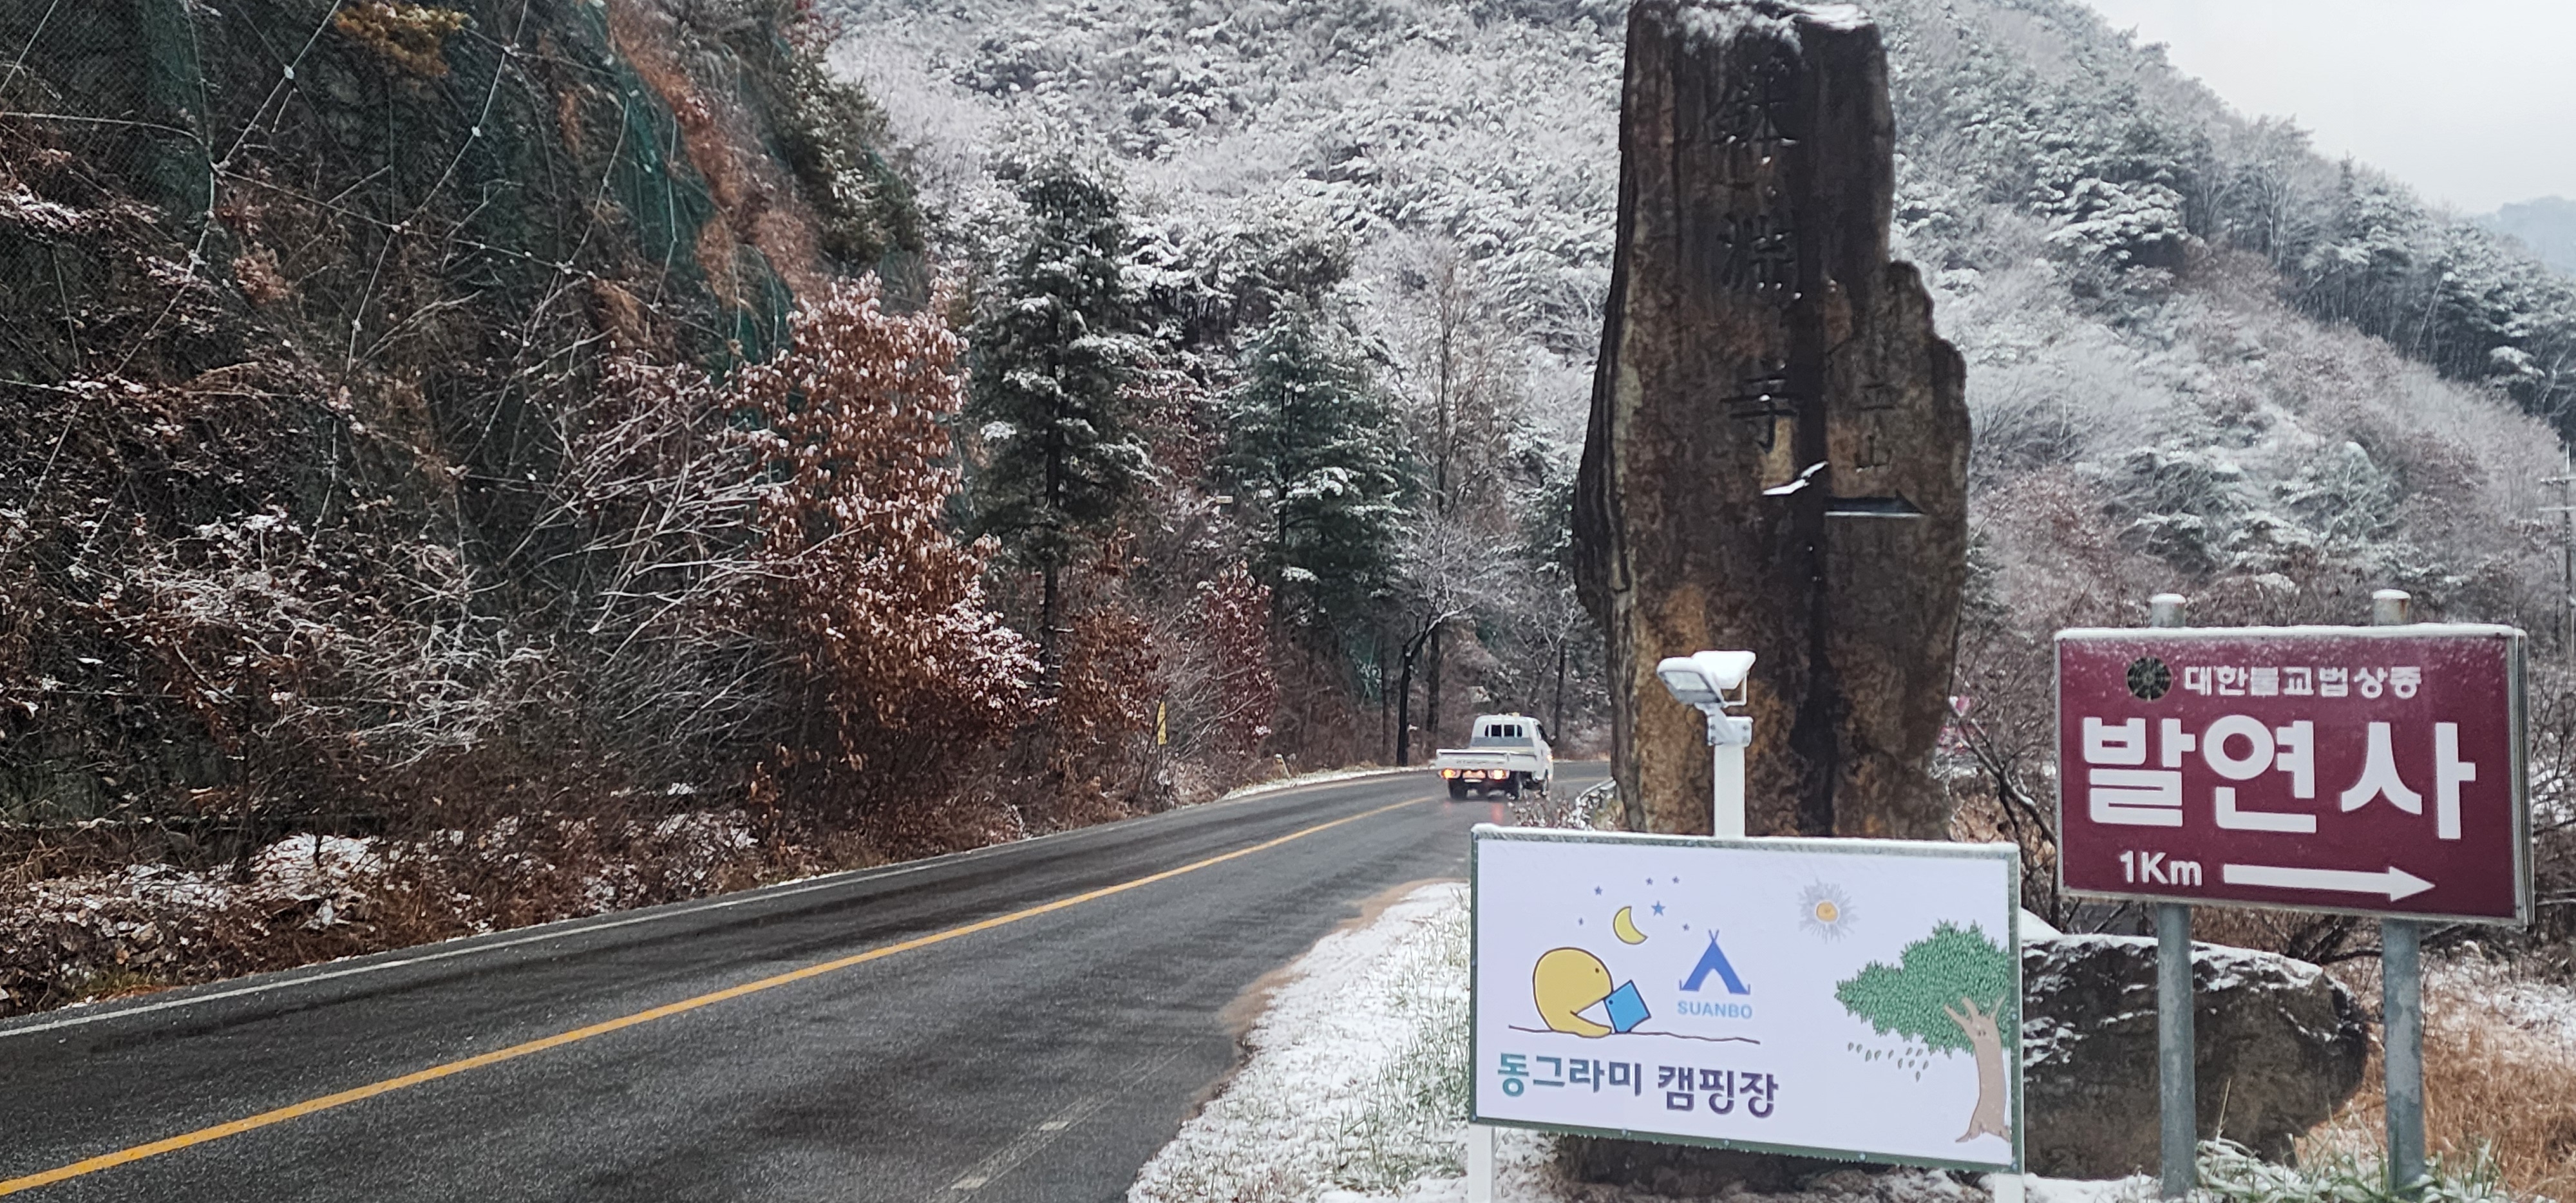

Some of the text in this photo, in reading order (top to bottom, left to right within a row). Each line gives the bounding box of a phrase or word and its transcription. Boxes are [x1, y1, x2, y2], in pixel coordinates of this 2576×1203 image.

[2184, 665, 2422, 699] 대한불교법상종
[2083, 715, 2476, 840] 발연사
[2119, 850, 2202, 886] 1Km
[1676, 999, 1754, 1020] SUANBO
[1497, 1052, 1779, 1119] 동그라미 캠핑장
